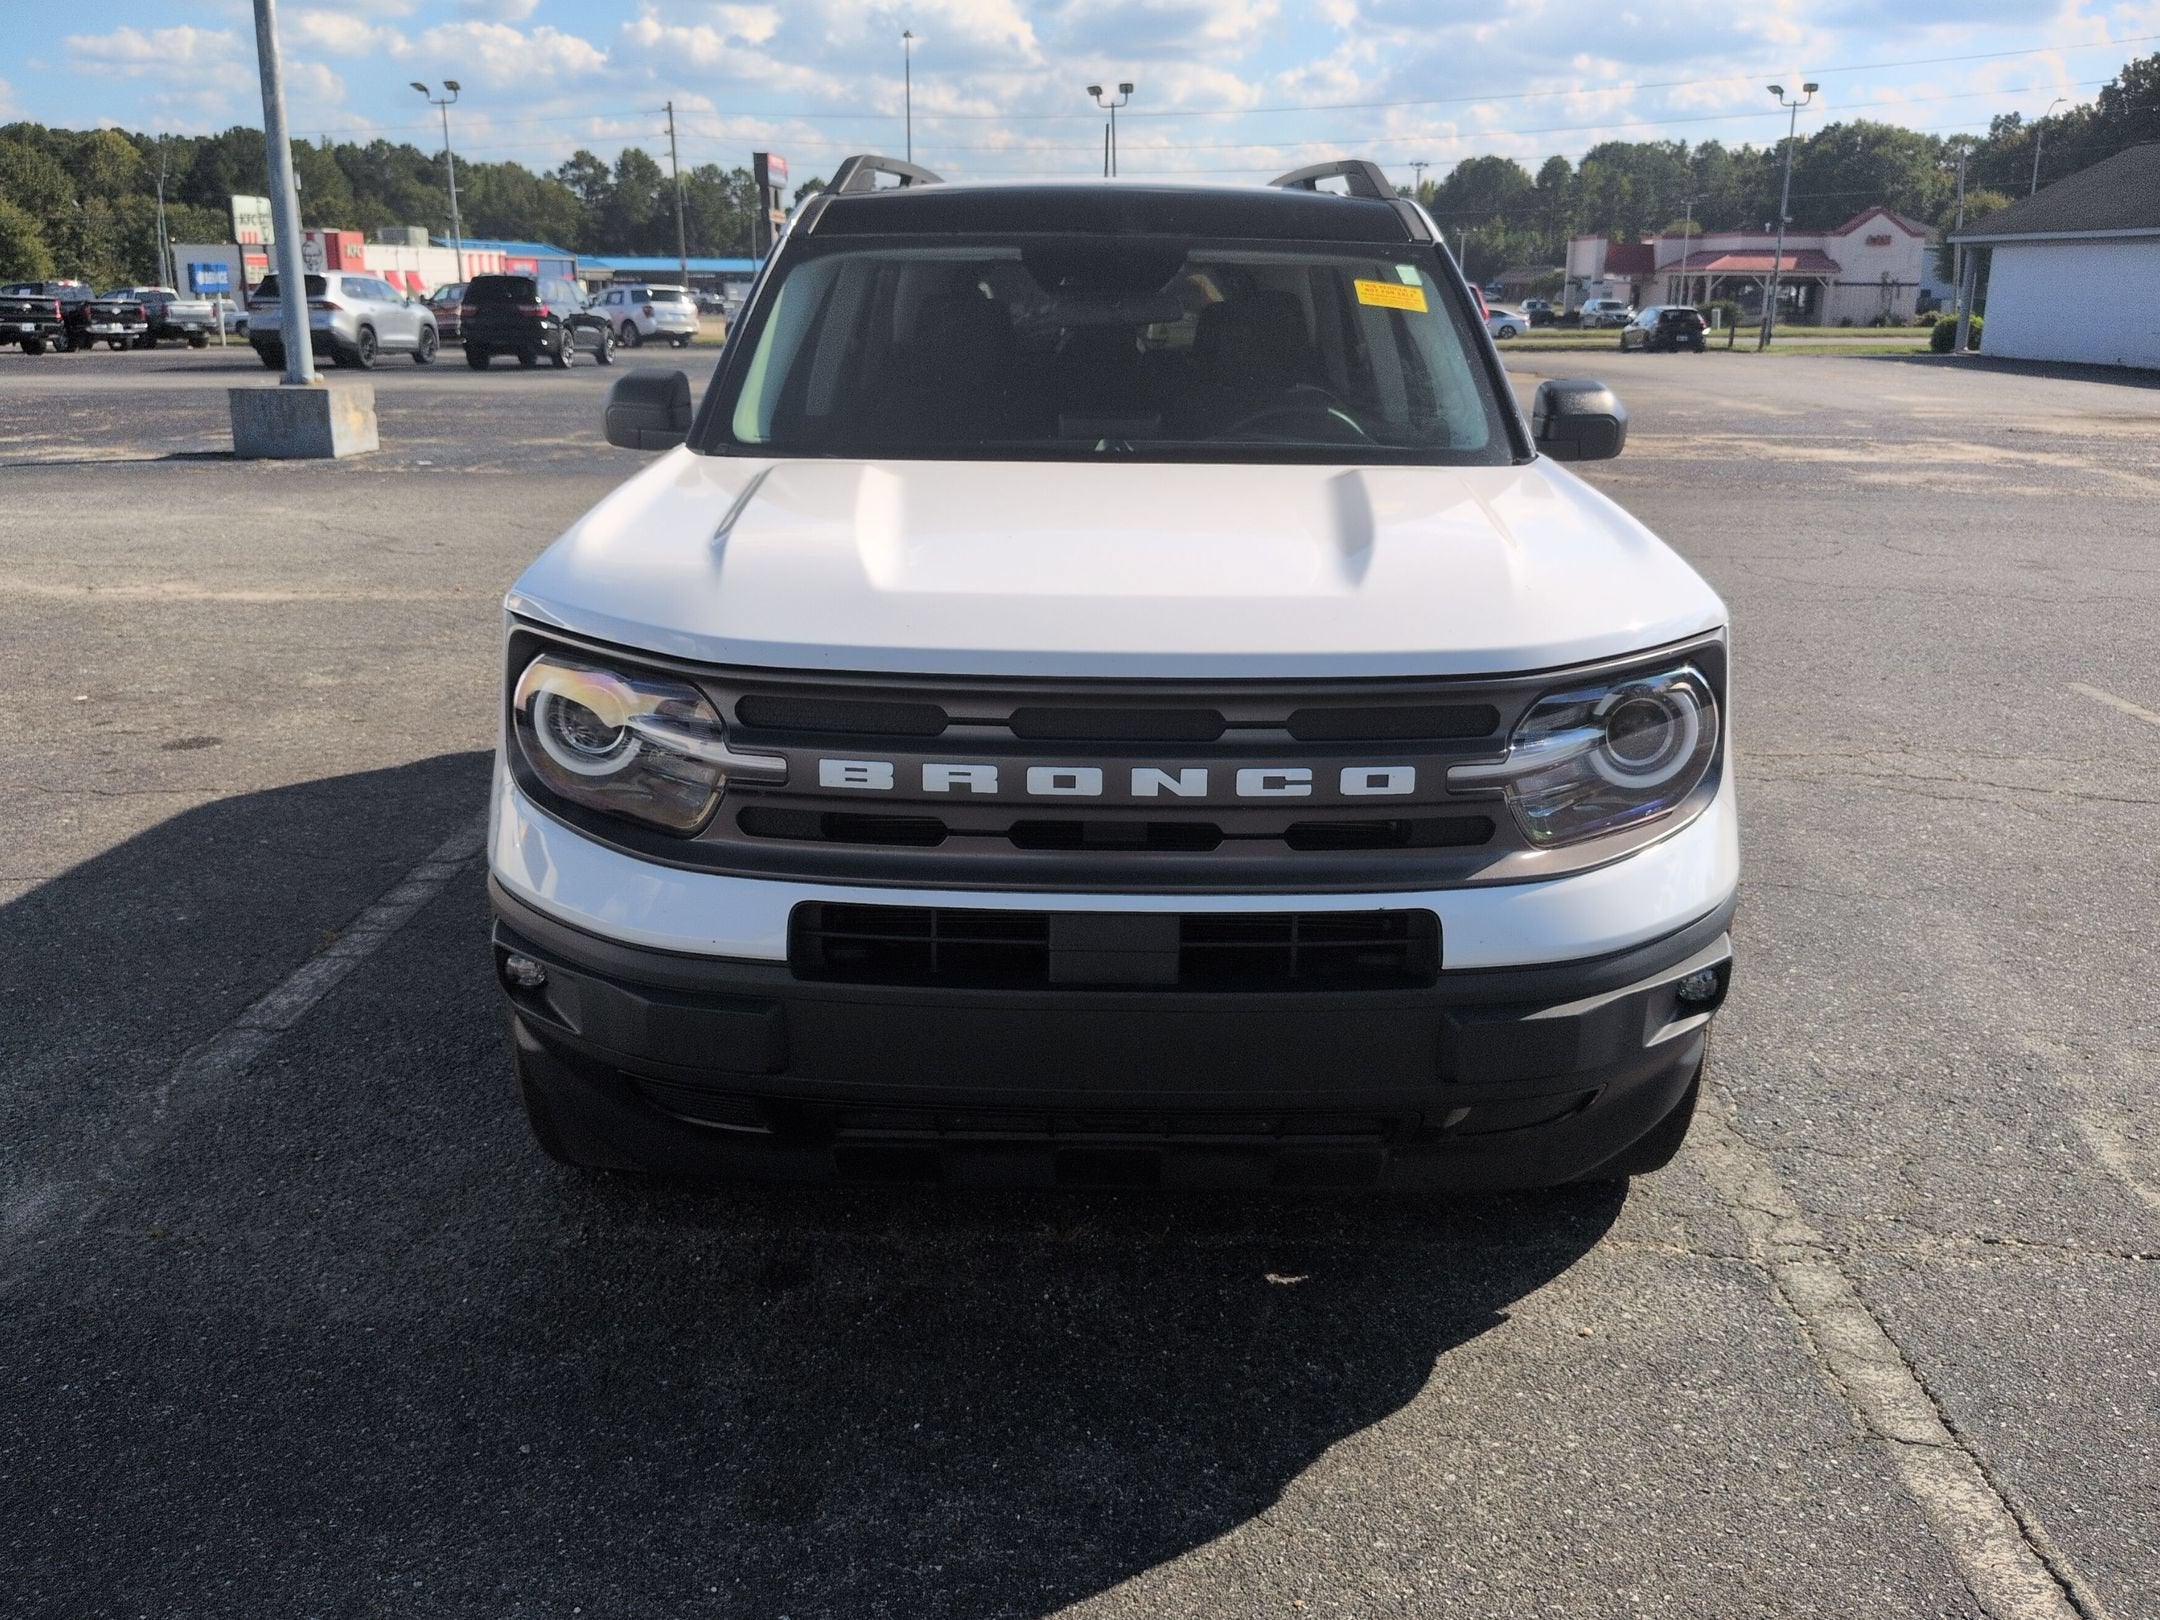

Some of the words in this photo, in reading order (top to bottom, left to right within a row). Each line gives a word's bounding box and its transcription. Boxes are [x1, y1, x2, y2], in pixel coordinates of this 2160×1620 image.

[240, 213, 257, 225] KFC
[345, 244, 364, 257] KFC
[818, 758, 1416, 797] BRONCO
